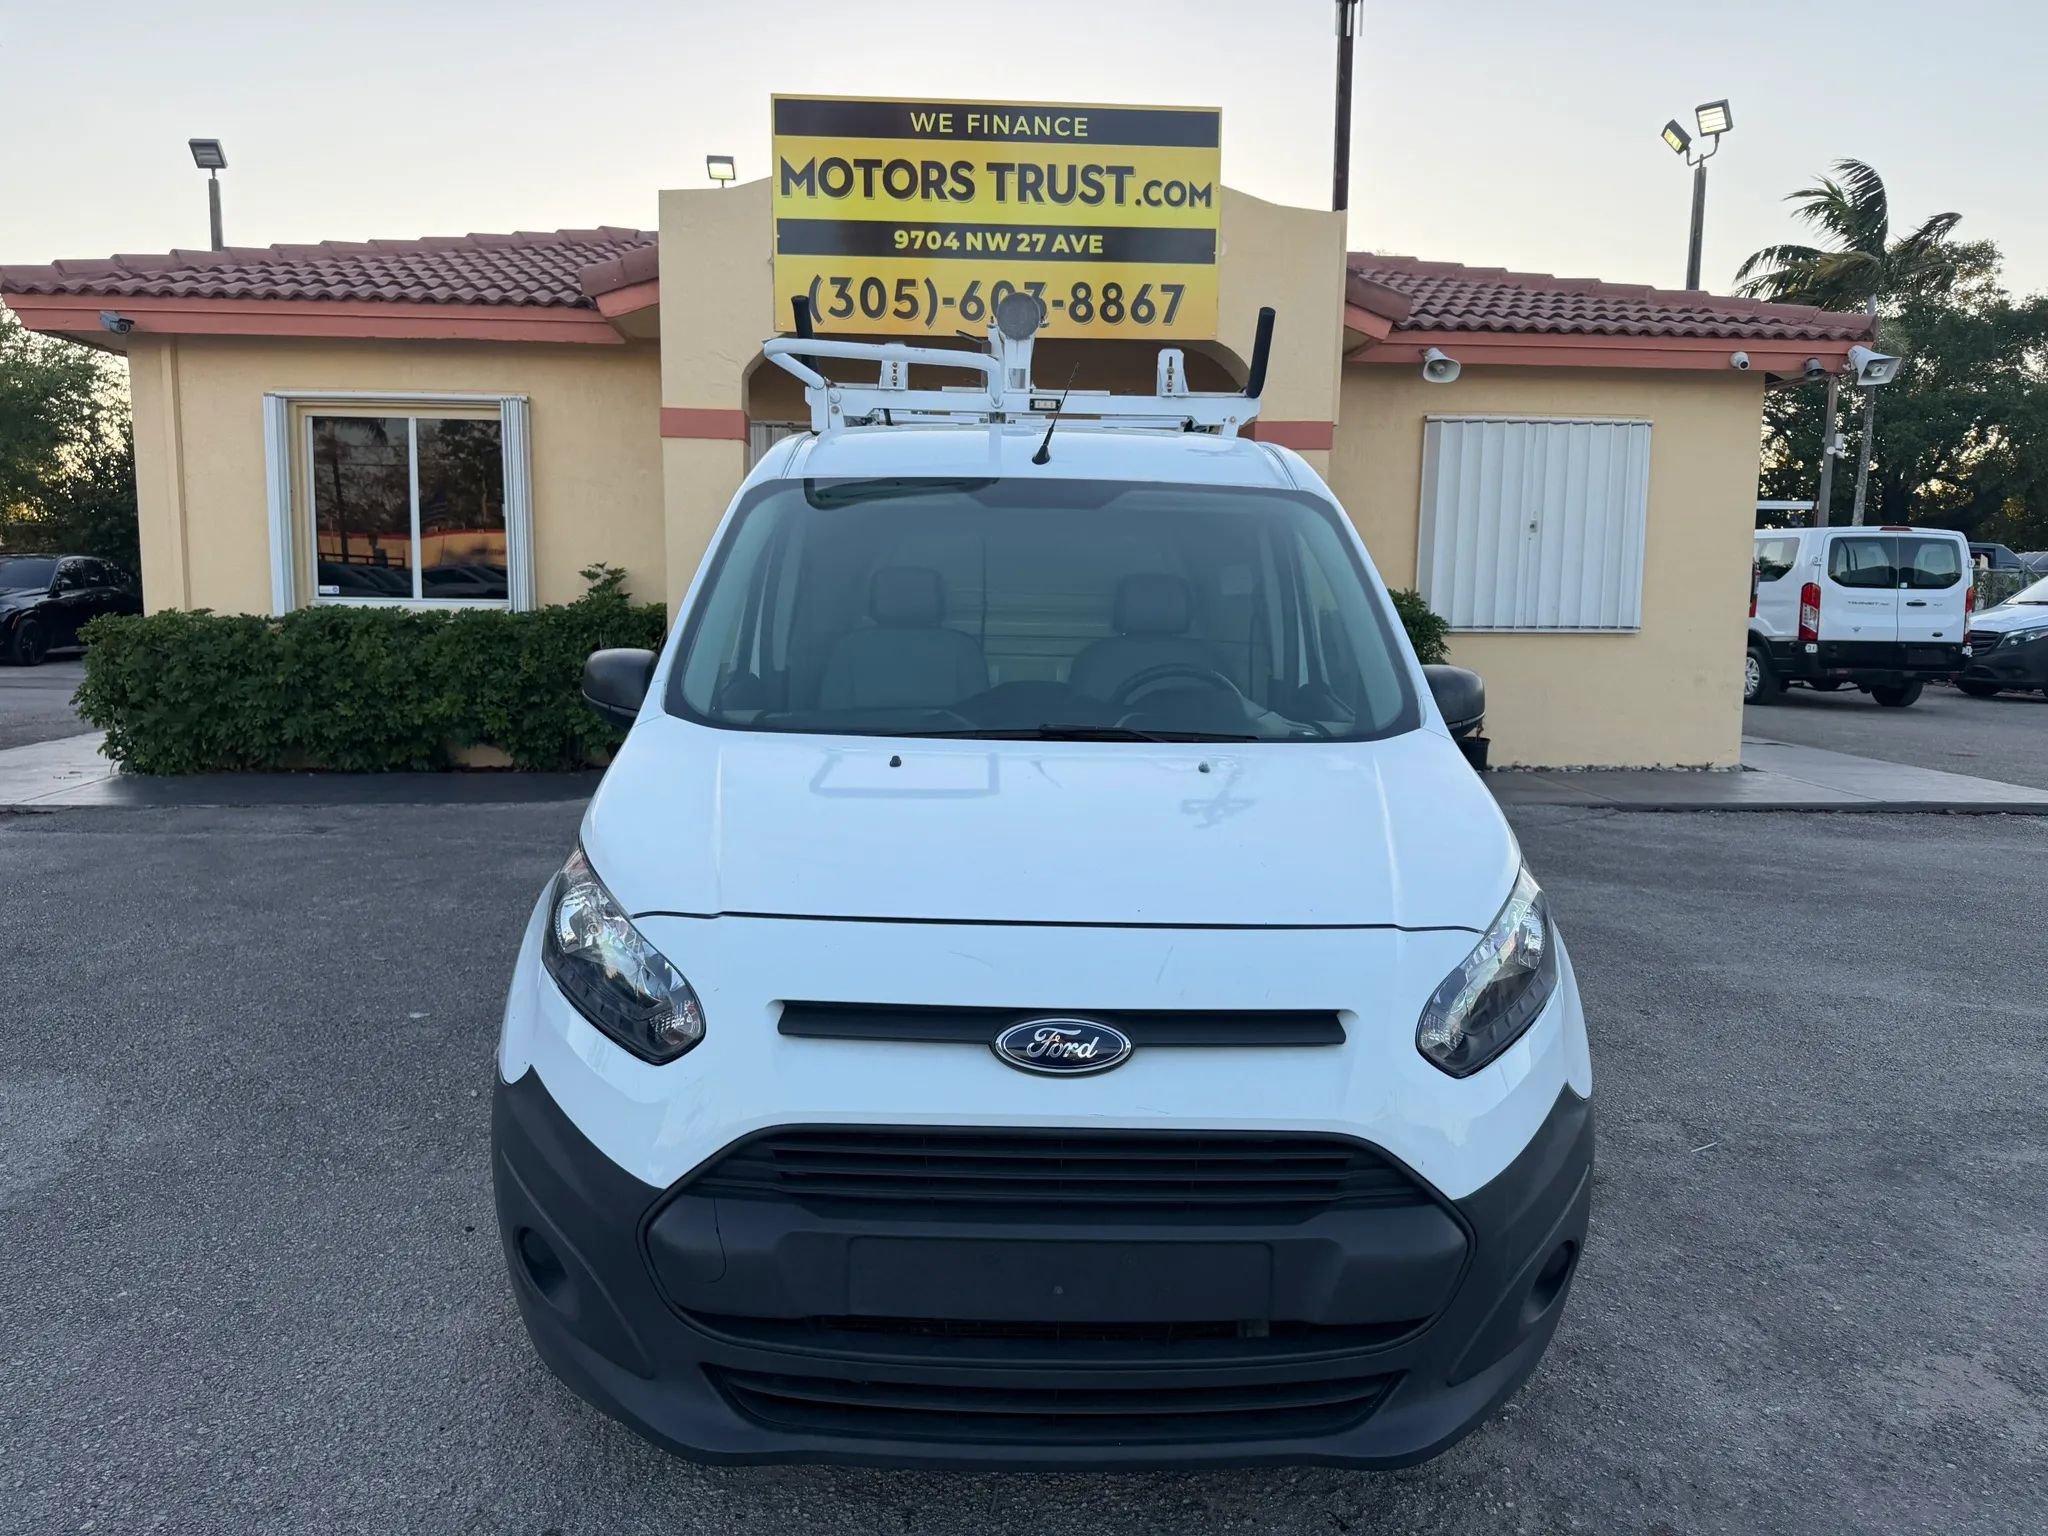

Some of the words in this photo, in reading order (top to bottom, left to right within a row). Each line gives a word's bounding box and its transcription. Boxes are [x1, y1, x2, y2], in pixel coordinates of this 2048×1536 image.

[911, 112, 953, 133] WE
[967, 114, 1089, 137] FINANCE
[779, 156, 976, 200] MOTORS
[894, 230, 960, 250] 9704
[966, 232, 1011, 252] NW
[1016, 234, 1046, 252] 27
[1051, 235, 1104, 254] AVE
[1026, 1027, 1100, 1058] Ford
